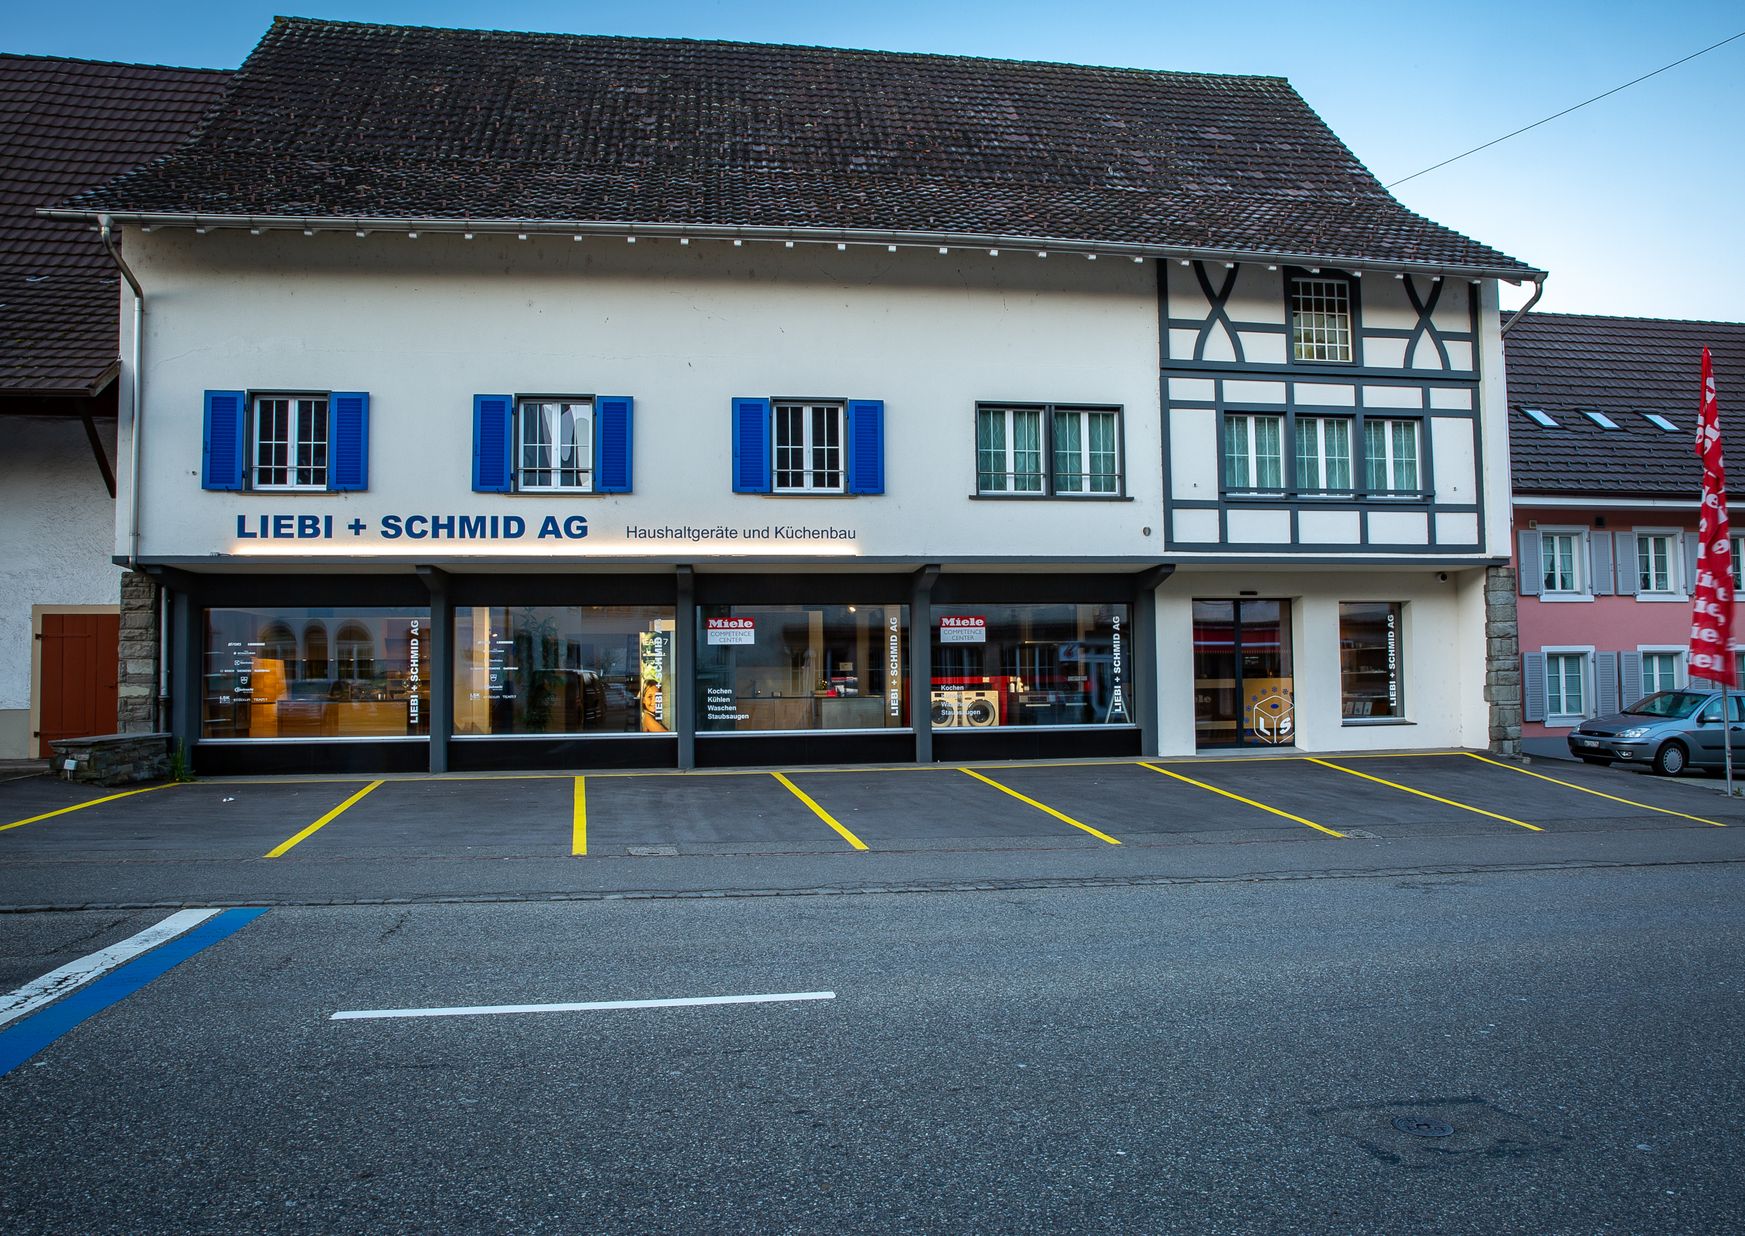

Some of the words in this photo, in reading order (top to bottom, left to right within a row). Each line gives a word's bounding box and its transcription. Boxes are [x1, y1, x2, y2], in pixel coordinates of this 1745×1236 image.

[236, 514, 333, 539] LIEBI
[347, 518, 367, 536] +
[380, 514, 526, 539] SCHMID
[537, 514, 589, 539] AG
[626, 525, 738, 541] Haushaltgeräte
[742, 526, 770, 539] und
[774, 526, 856, 540] Küchenbau
[410, 619, 419, 636] AG
[708, 619, 753, 628] Miele
[889, 616, 898, 632] AG
[941, 617, 984, 627] Miele
[1112, 615, 1120, 631] AG
[1387, 614, 1395, 629] AG
[410, 639, 419, 682] SCHMID
[654, 636, 663, 680] SCHMID
[889, 634, 898, 677] SCHMID
[1112, 633, 1121, 674] SCHMID
[1387, 630, 1396, 670] SCHMID
[411, 684, 418, 692] +
[1113, 685, 1122, 713] LIEBI
[1388, 680, 1397, 707] LIEBI
[410, 694, 419, 724] LIEBI
[654, 692, 663, 721] LIEBI
[890, 688, 899, 717] LIEBI
[1259, 716, 1271, 736] L
[1280, 716, 1292, 735] S
